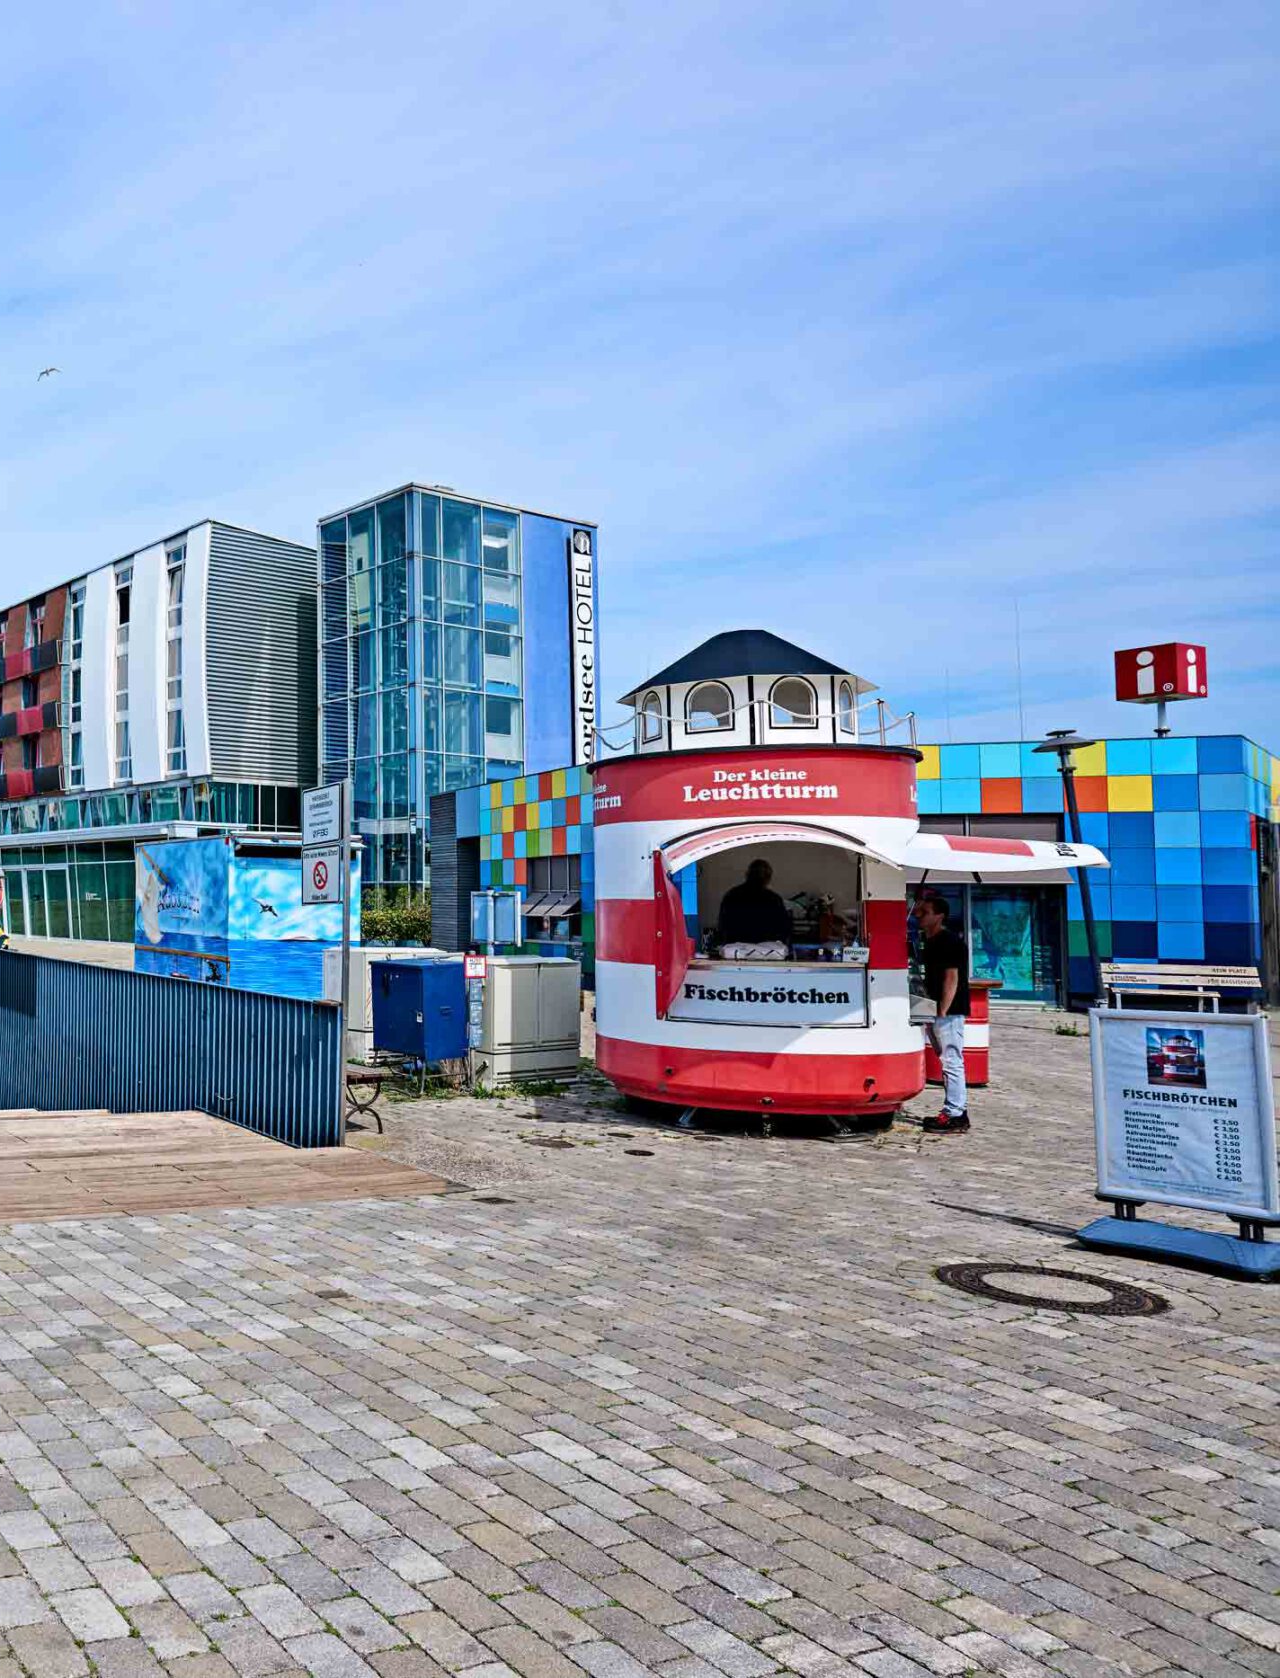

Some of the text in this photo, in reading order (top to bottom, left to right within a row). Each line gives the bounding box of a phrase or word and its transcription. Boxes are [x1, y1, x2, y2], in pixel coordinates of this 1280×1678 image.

[576, 562, 595, 765] ordsee HOTEL
[713, 769, 807, 782] Der kleine
[682, 783, 839, 803] Leuchtturm
[683, 983, 850, 1004] Fischbrötchen
[1122, 1089, 1238, 1108] FISCHBRÖTCHEN
[1124, 1109, 1161, 1119] Brathering
[1124, 1116, 1180, 1128] Bismarckhering
[1142, 1125, 1166, 1133] Matjes
[1127, 1155, 1156, 1164] Krabben
